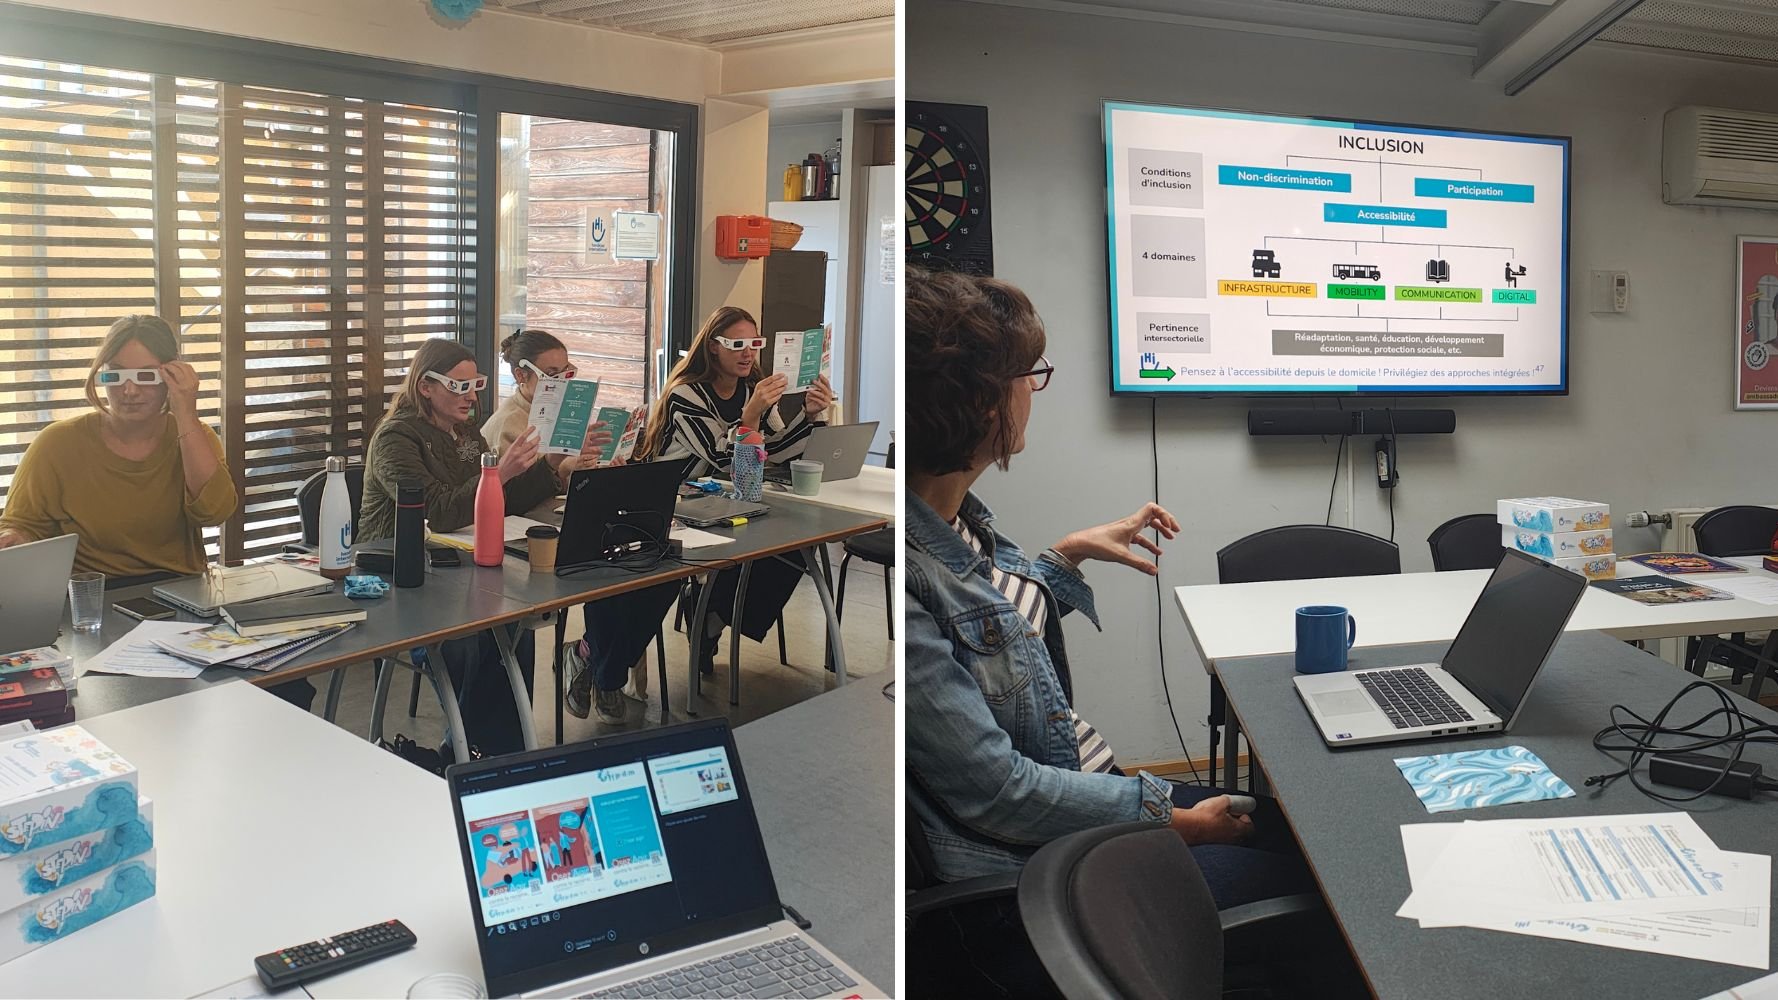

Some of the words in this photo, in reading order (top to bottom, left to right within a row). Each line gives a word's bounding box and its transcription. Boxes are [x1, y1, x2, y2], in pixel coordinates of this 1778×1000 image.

[1339, 135, 1424, 154] INCLUSION
[1141, 166, 1192, 178] Conditions
[1238, 170, 1333, 187] Non-discrimination
[1141, 179, 1192, 190] d'inclusion
[1447, 184, 1503, 197] Participation
[1358, 209, 1416, 222] Accessibilité
[1142, 252, 1148, 260] 4
[1151, 252, 1196, 262] domaines
[1224, 283, 1312, 295] INFRASTRUCTURE
[1335, 287, 1378, 297] MOBILITY
[1401, 289, 1476, 299] COMMUNICATION
[1498, 292, 1530, 301] DIGITAL
[1149, 323, 1199, 333] Pertinence
[1144, 334, 1204, 343] intersectorielle
[1294, 332, 1353, 343] Réadaptation,
[1355, 333, 1380, 344] santé,
[1382, 334, 1423, 344] éducation,
[1425, 335, 1485, 345] développement
[1320, 344, 1372, 354] économique,
[1374, 344, 1415, 354] protection
[1417, 345, 1446, 354] sociale,
[1447, 346, 1462, 354] etc.
[1180, 367, 1216, 376] Pensez
[1219, 366, 1225, 376] à
[1294, 367, 1325, 379] depuis
[1327, 368, 1335, 377] le
[1339, 368, 1376, 377] domicile
[1383, 368, 1428, 379] Privilégiez
[1430, 368, 1446, 377] des
[1448, 369, 1491, 379] approches
[1492, 369, 1530, 379] intégrées
[1535, 364, 1545, 373] 47
